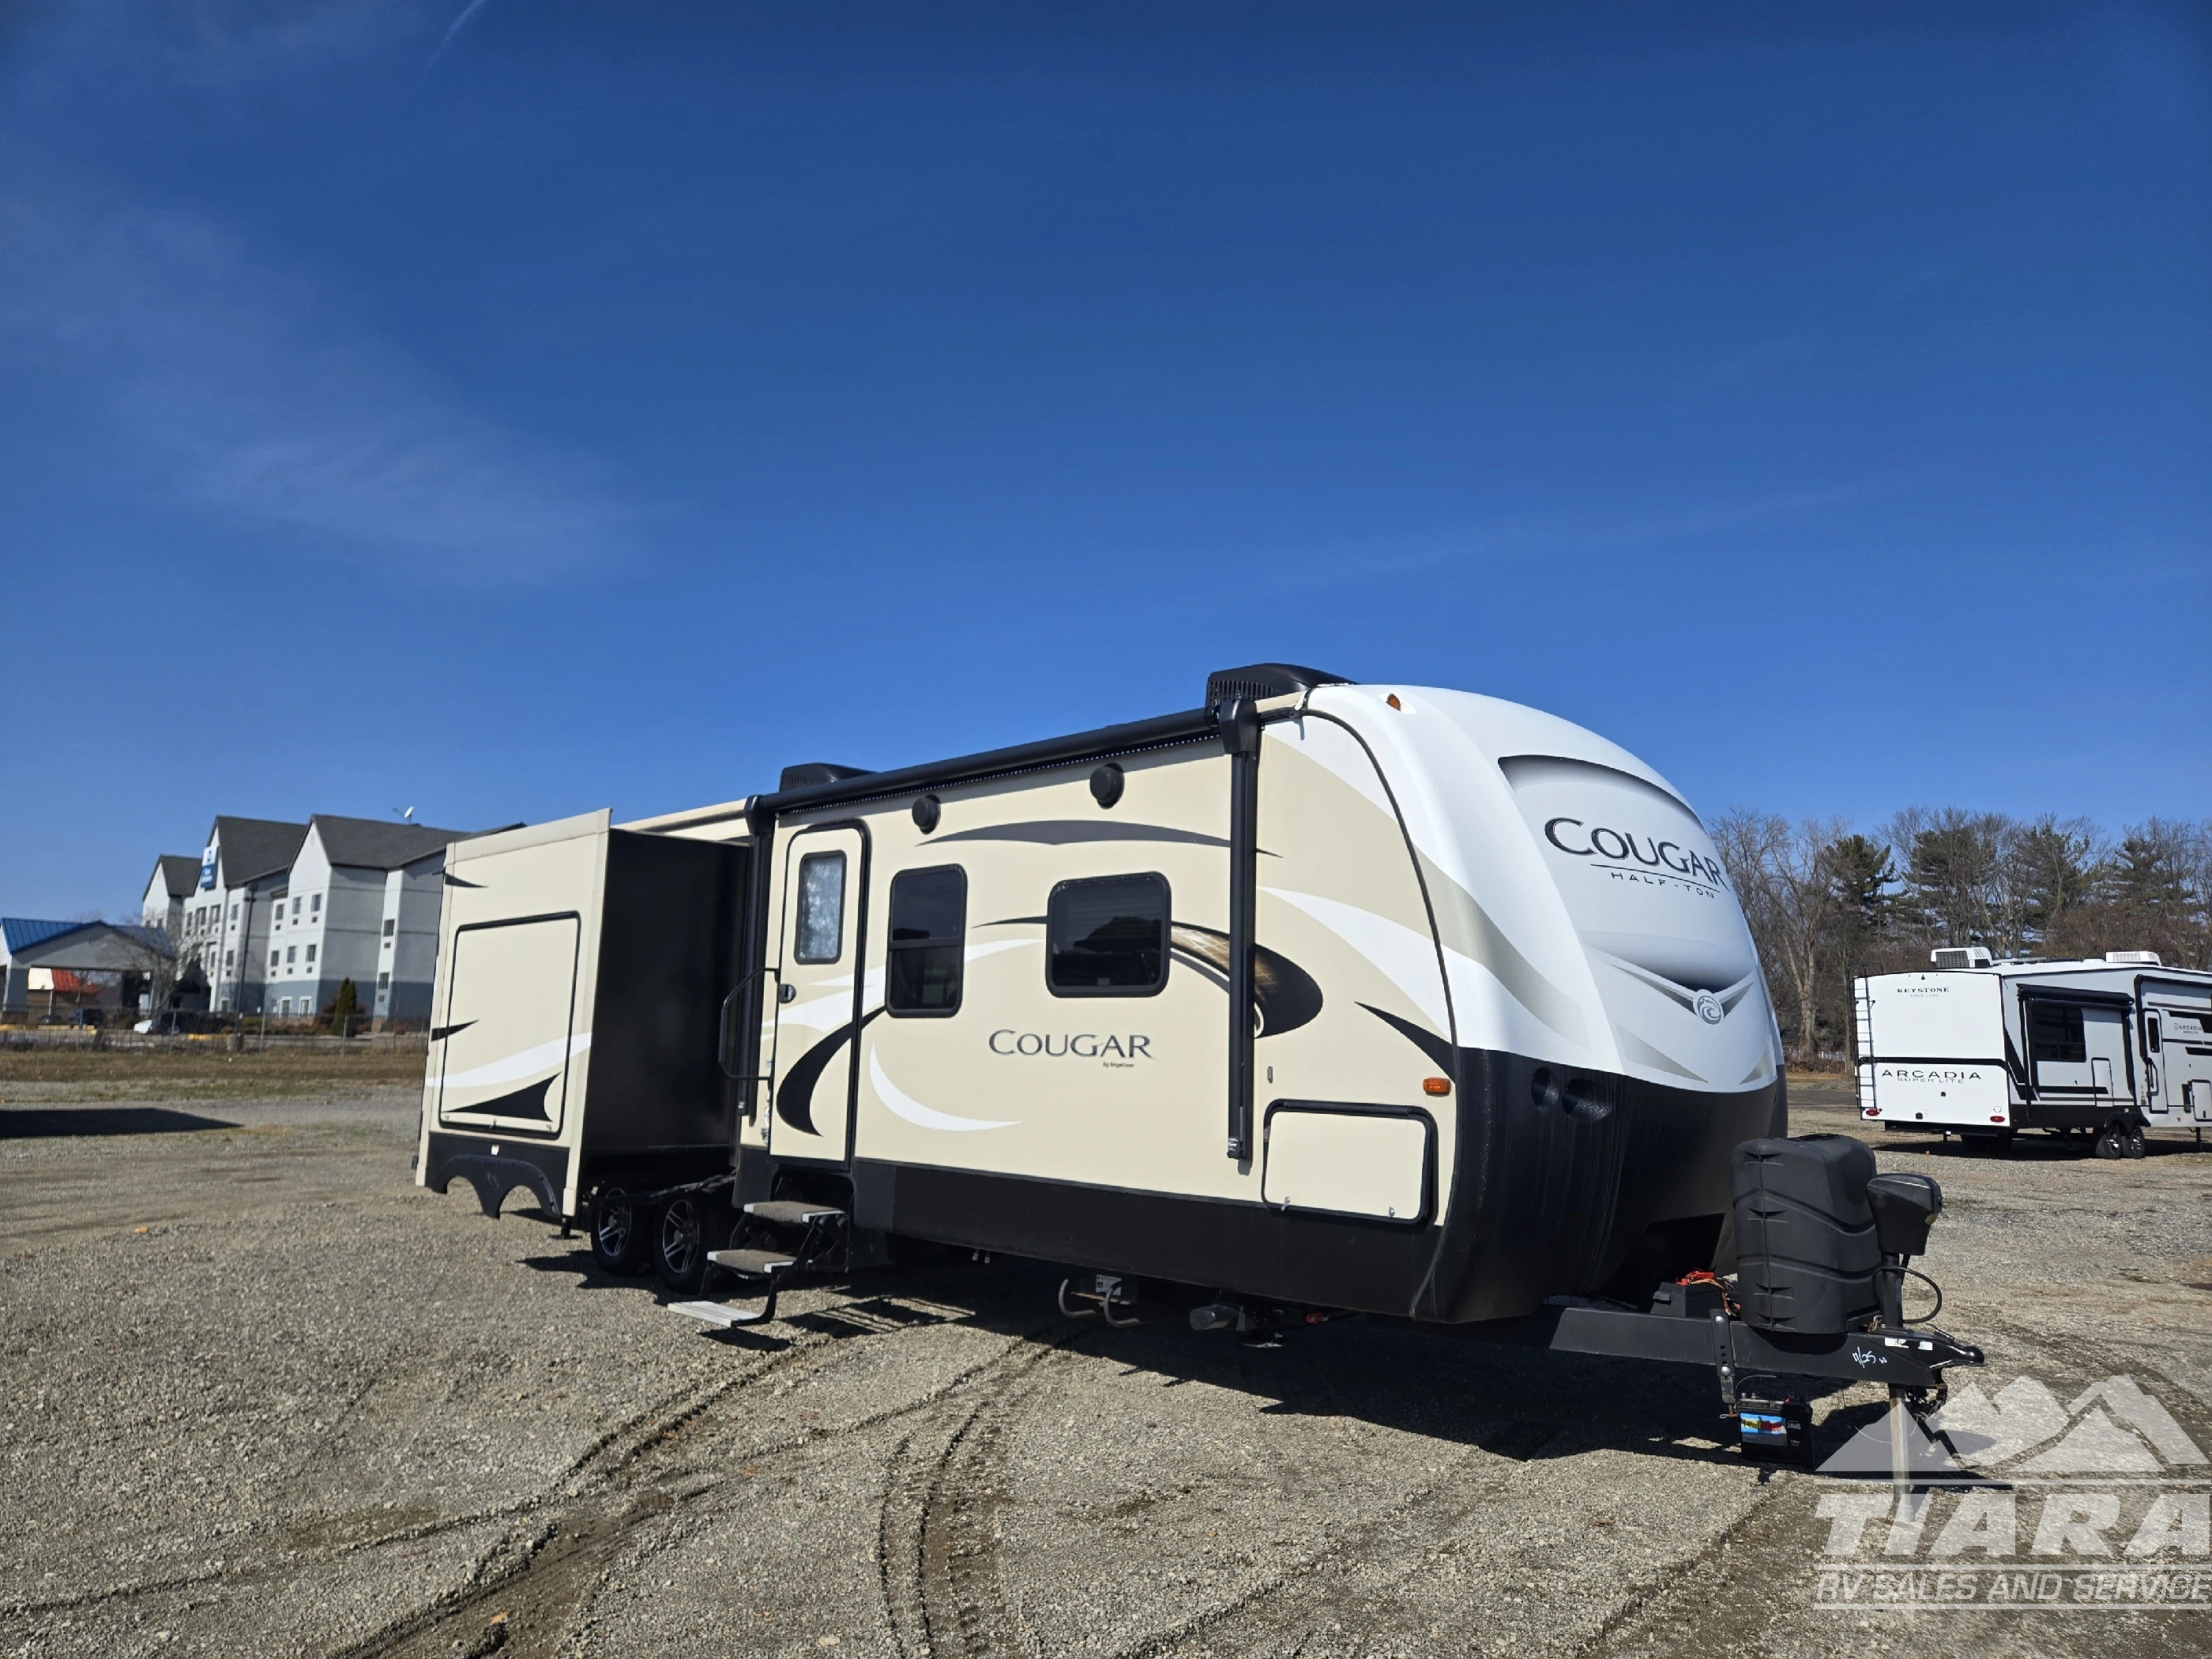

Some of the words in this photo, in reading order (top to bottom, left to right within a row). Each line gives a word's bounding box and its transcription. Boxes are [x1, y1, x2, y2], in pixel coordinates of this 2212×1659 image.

[1544, 817, 1731, 893] COUGAR
[1611, 871, 1715, 899] HALF-TON
[988, 1029, 1156, 1059] COUGAR
[1882, 1070, 1981, 1080] ARCADIA
